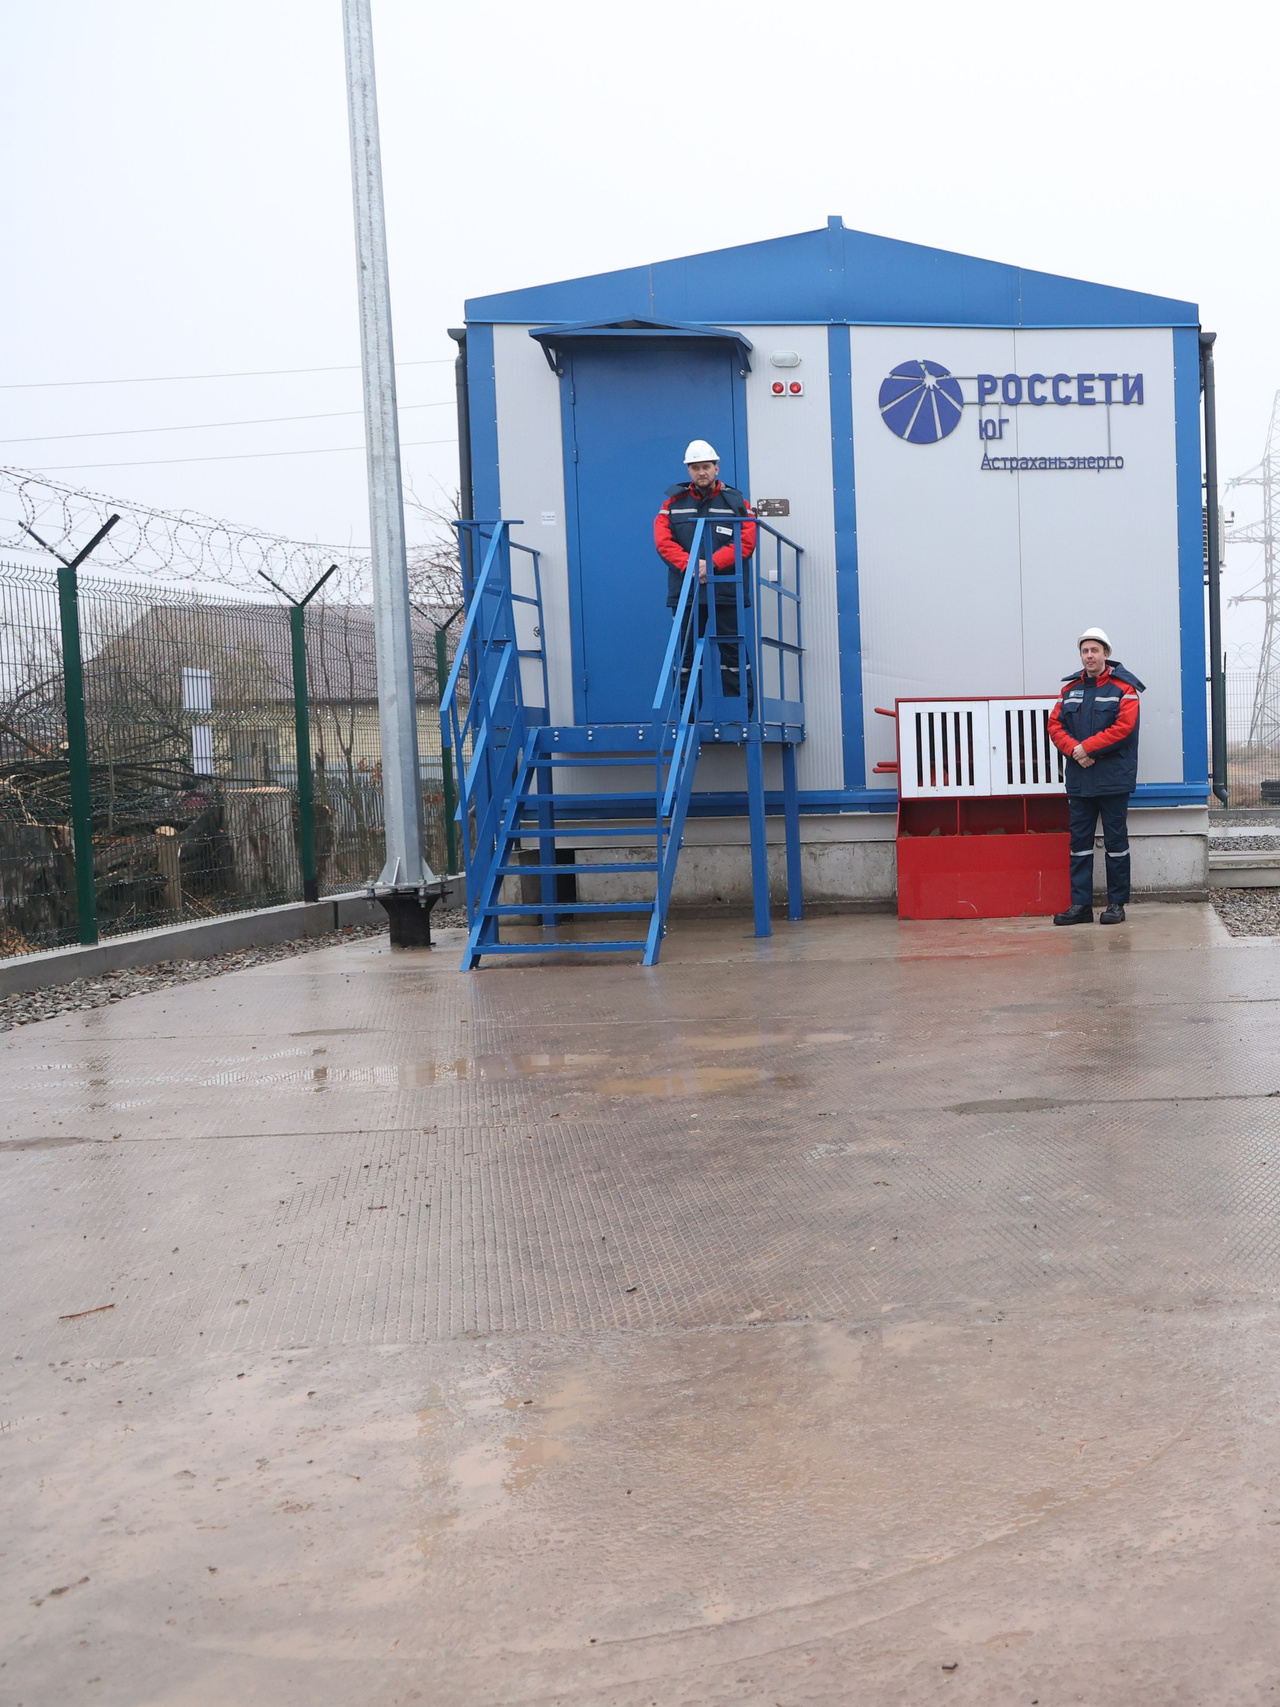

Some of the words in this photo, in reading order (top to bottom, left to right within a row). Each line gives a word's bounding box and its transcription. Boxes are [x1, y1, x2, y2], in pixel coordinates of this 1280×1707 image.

[977, 373, 1144, 406] РОССЕТИ
[979, 418, 1010, 440] ЮГ
[980, 453, 1124, 473] Астраханьэнерго
